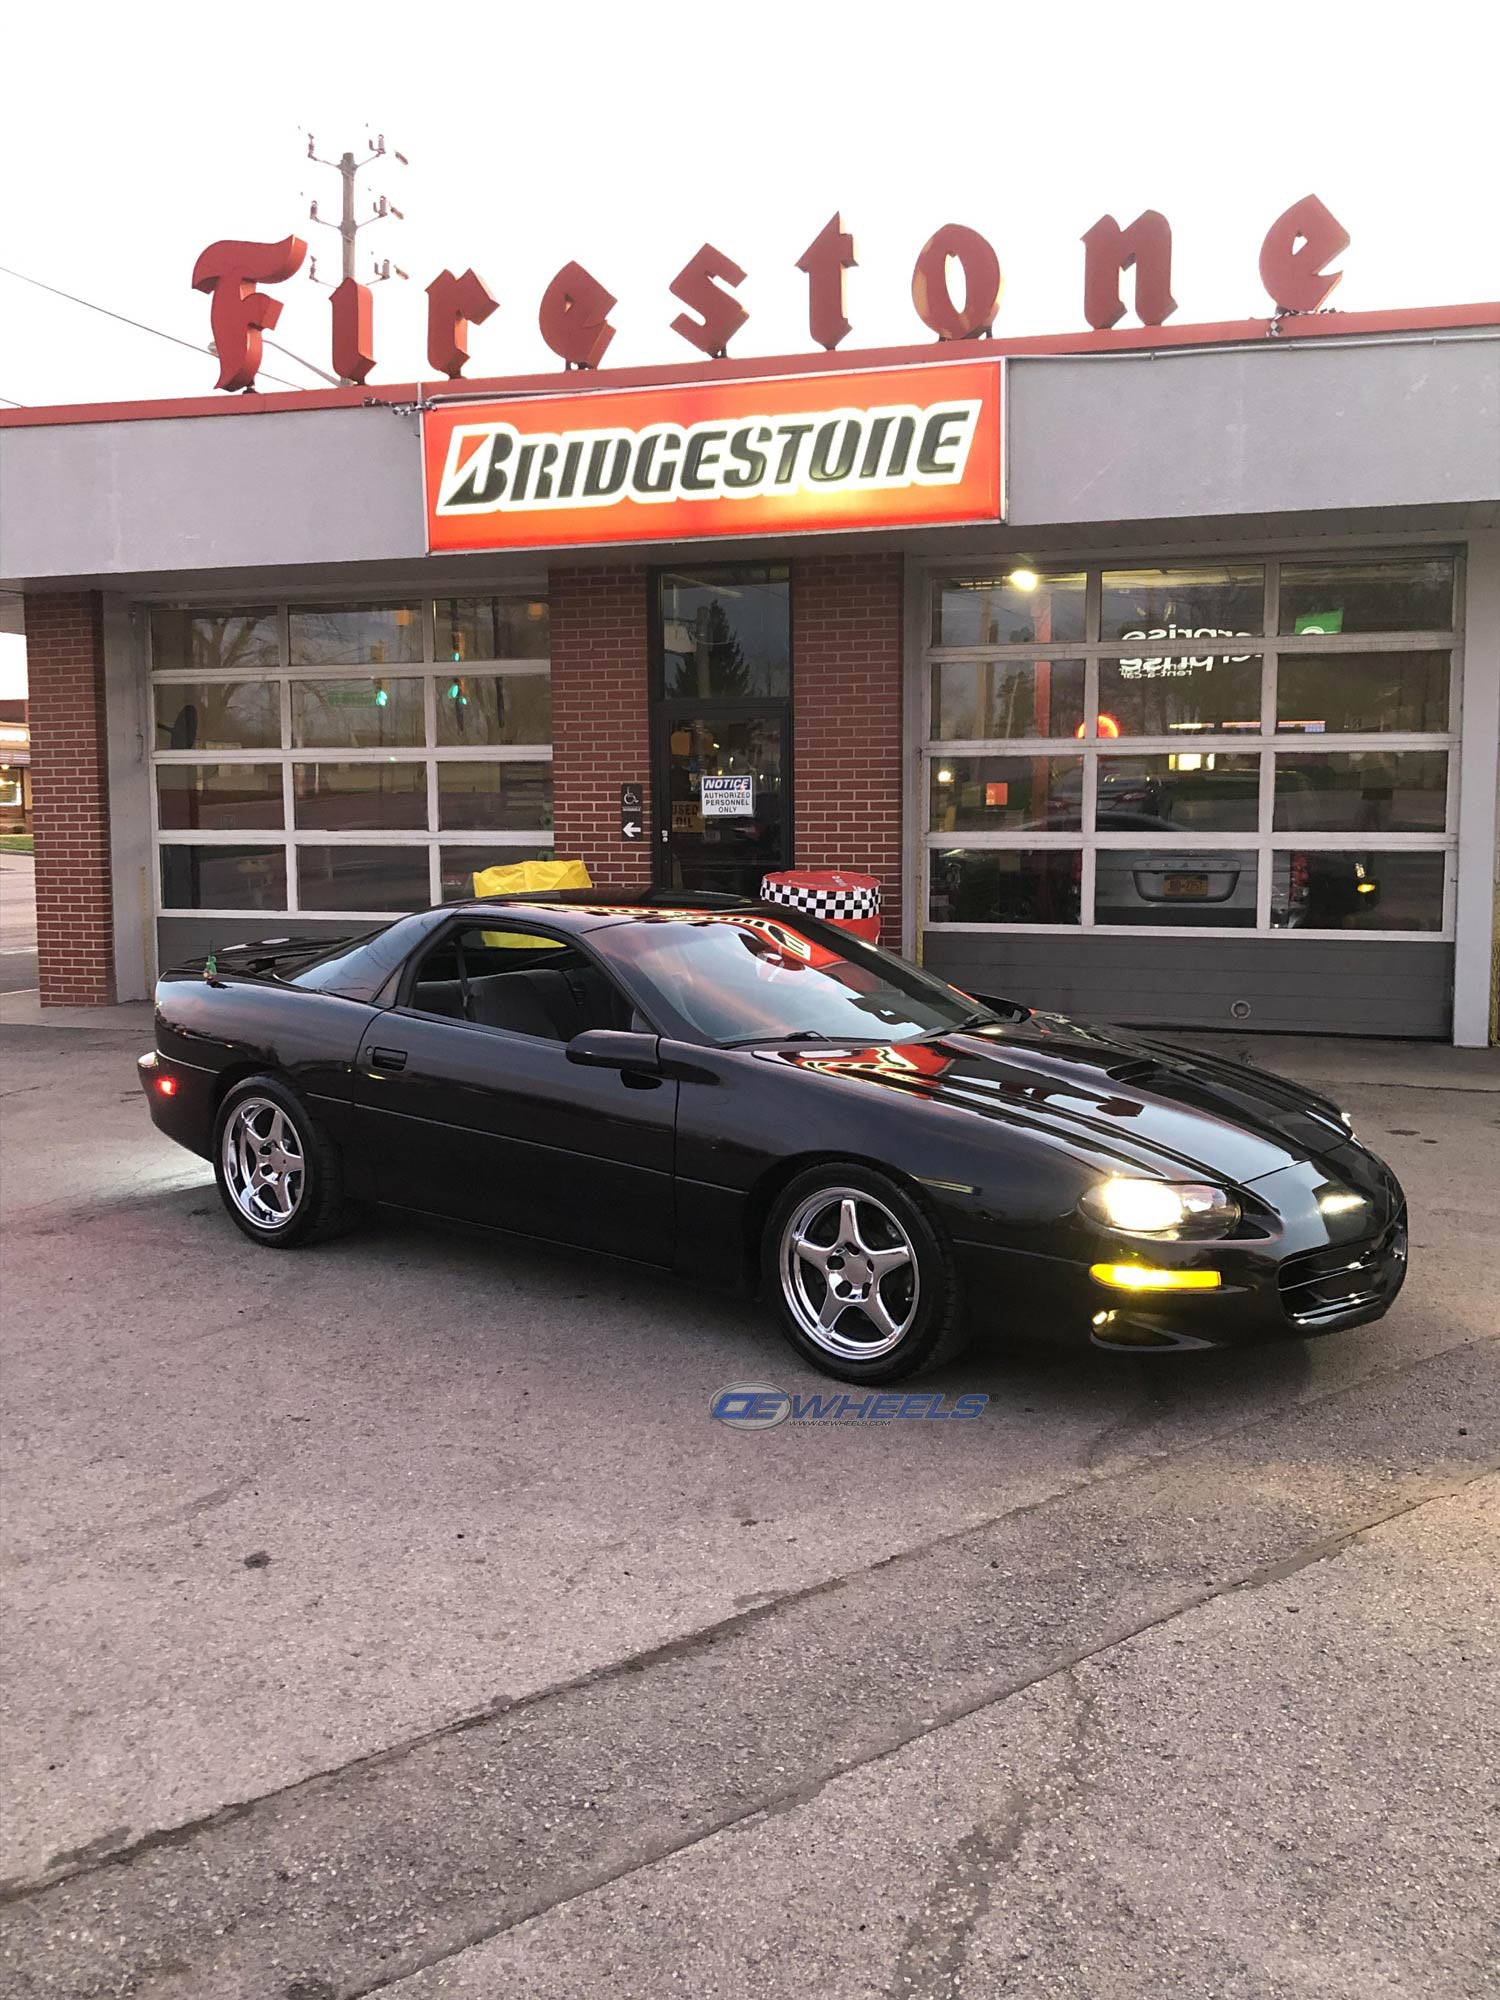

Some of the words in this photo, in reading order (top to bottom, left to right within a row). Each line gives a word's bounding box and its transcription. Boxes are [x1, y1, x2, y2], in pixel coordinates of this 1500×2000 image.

[191, 193, 1351, 392] Firestone
[443, 410, 970, 507] BRIDGESTONE
[704, 778, 750, 790] NOTICE
[704, 791, 751, 799] AUTHORIZED
